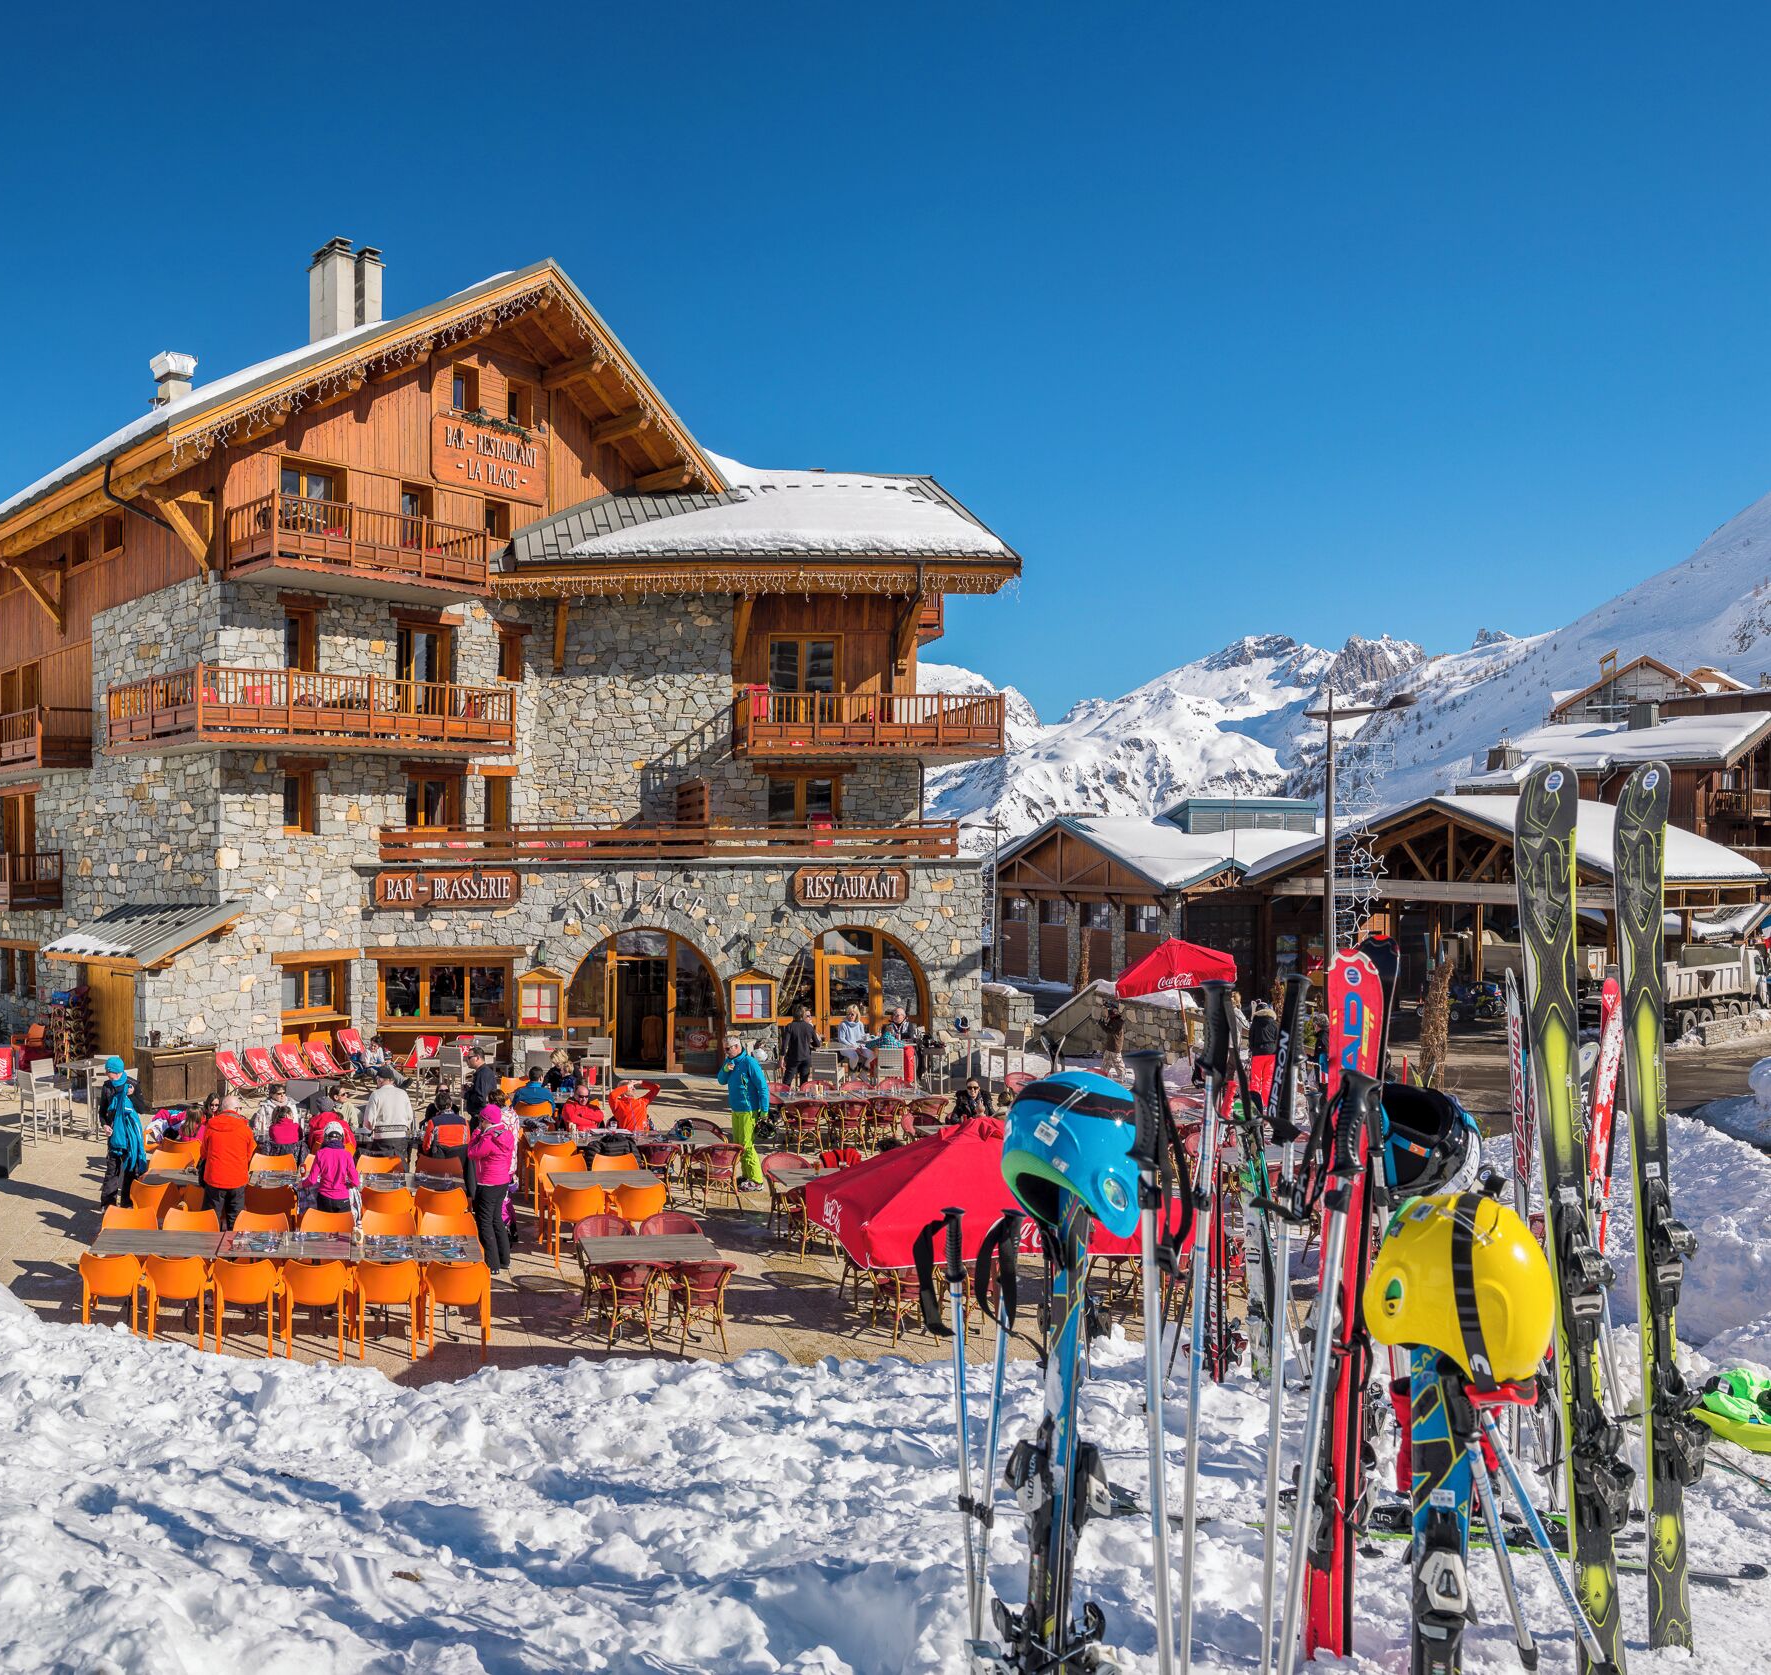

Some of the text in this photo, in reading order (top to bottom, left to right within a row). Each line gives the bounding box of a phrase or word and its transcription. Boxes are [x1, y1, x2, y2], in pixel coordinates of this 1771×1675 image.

[447, 425, 466, 449] BAR
[478, 433, 538, 468] RESTAURANT
[468, 458, 482, 481] LA
[488, 463, 518, 489] PLACE
[386, 878, 414, 900] BAR
[433, 877, 511, 899] BRASSERIE
[575, 880, 704, 919] LA PLACE
[805, 876, 899, 898] RESTAURANT
[1268, 1030, 1290, 1119] GIPRON
[1510, 1015, 1528, 1184] MADSHUS
